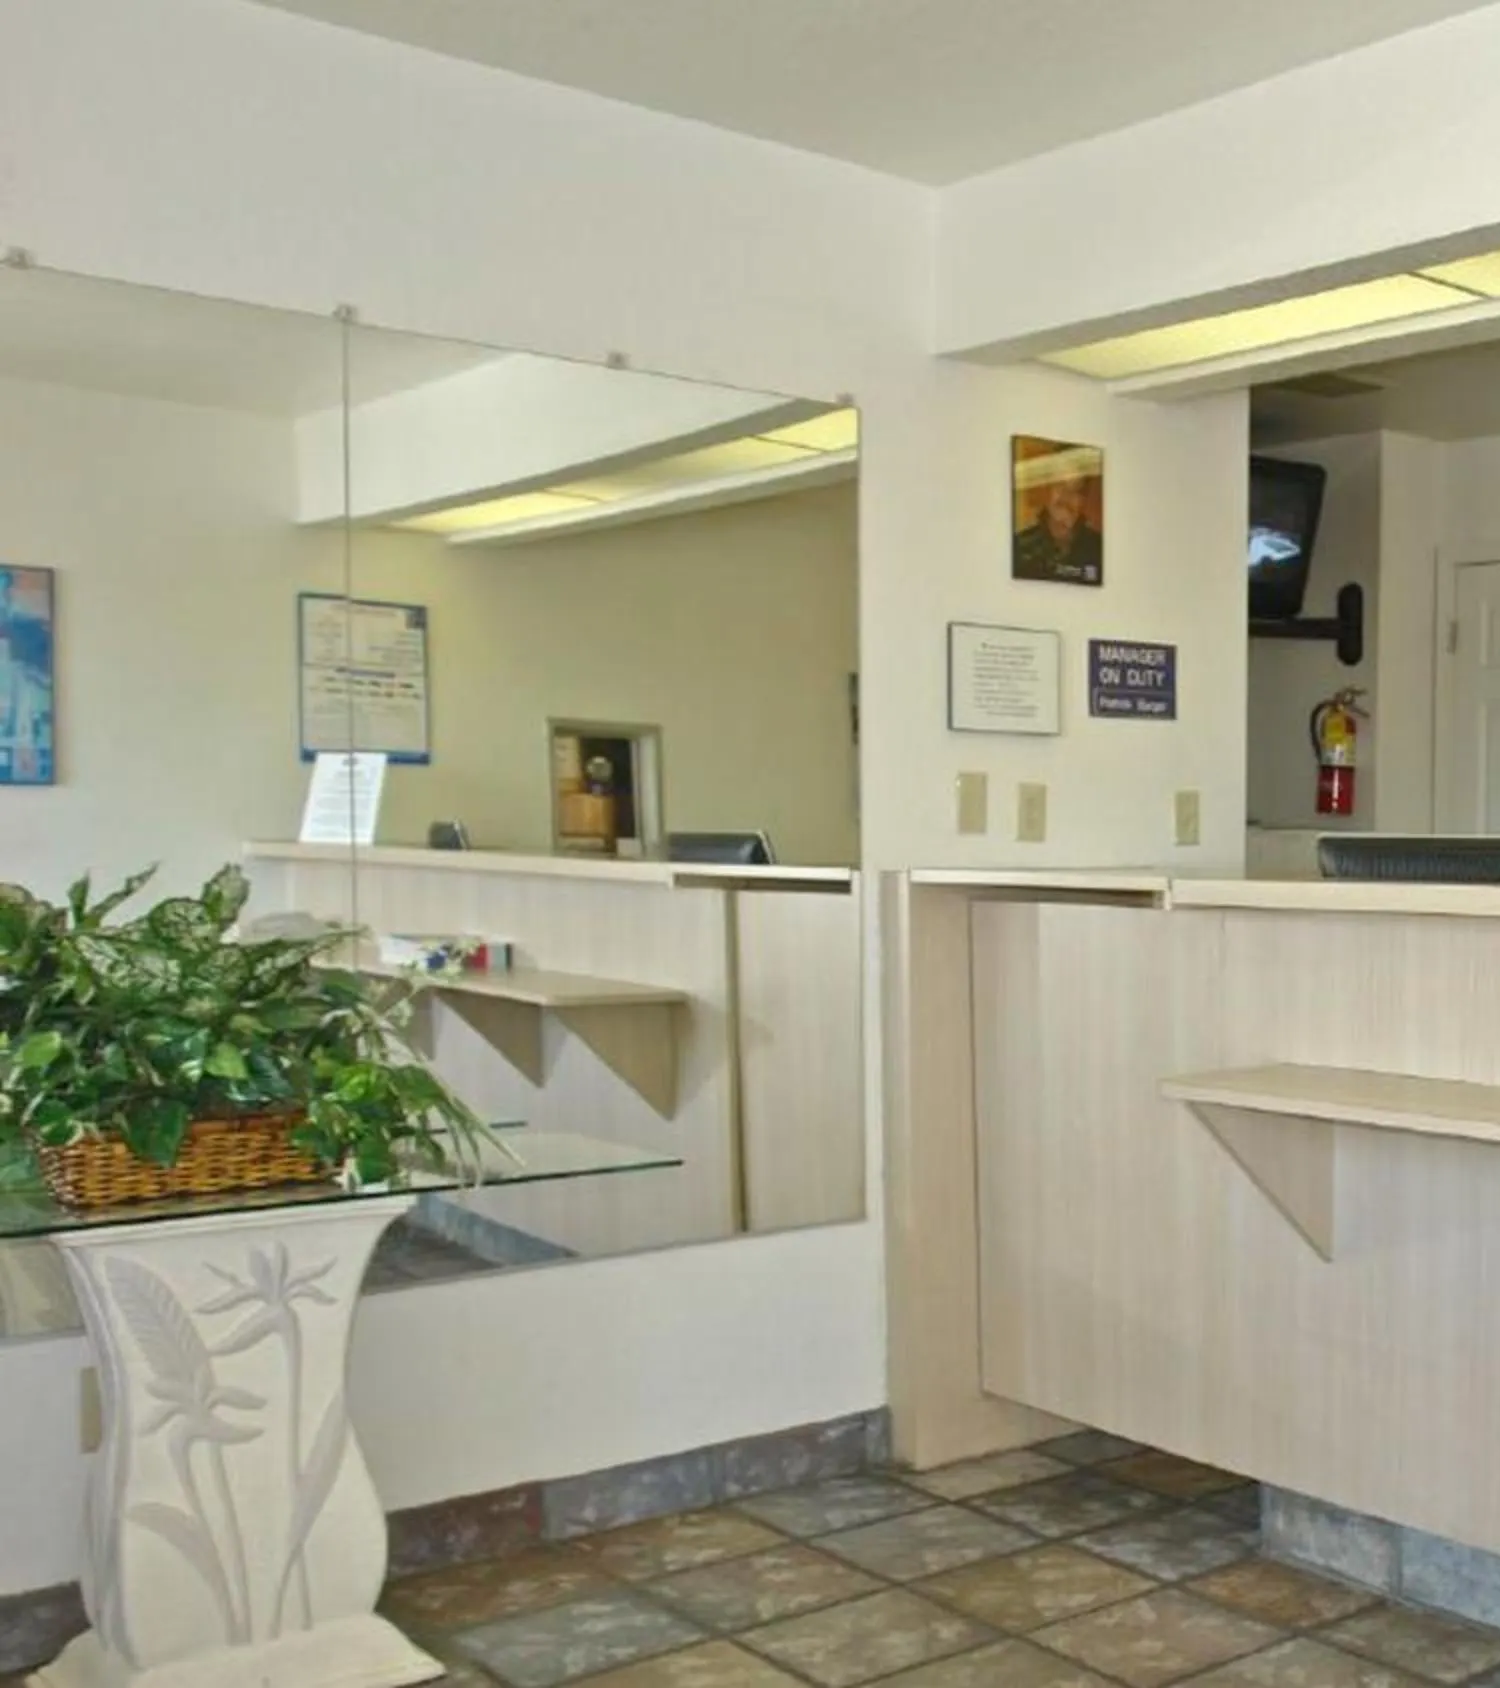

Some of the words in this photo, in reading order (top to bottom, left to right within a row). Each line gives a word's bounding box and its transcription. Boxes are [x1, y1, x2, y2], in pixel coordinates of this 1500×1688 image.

[1099, 644, 1166, 665] MANAGER
[1099, 666, 1121, 685] ON
[1126, 667, 1166, 687] DUTY
